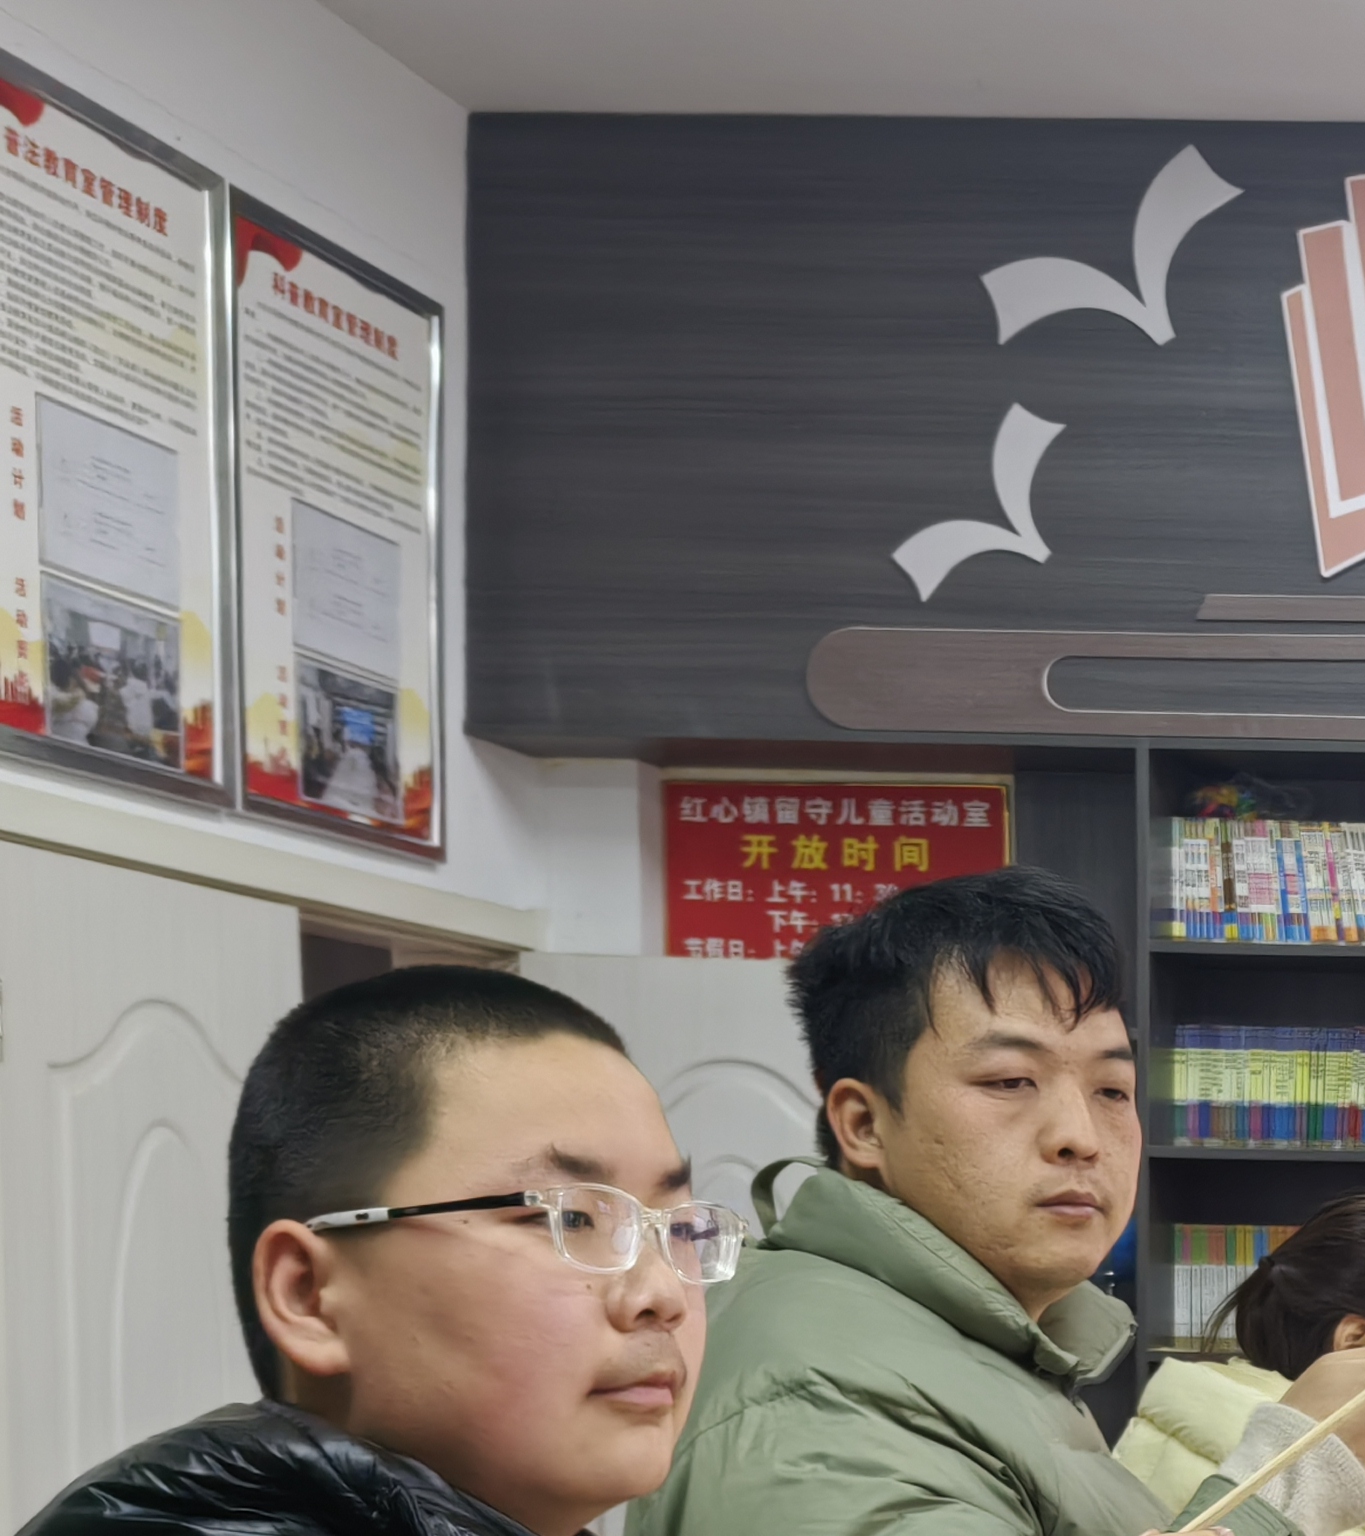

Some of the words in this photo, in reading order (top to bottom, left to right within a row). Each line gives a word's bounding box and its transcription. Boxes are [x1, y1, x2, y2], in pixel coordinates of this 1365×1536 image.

[679, 796, 993, 828] 红心镇留守儿童活动室
[740, 834, 930, 873] 开放时间
